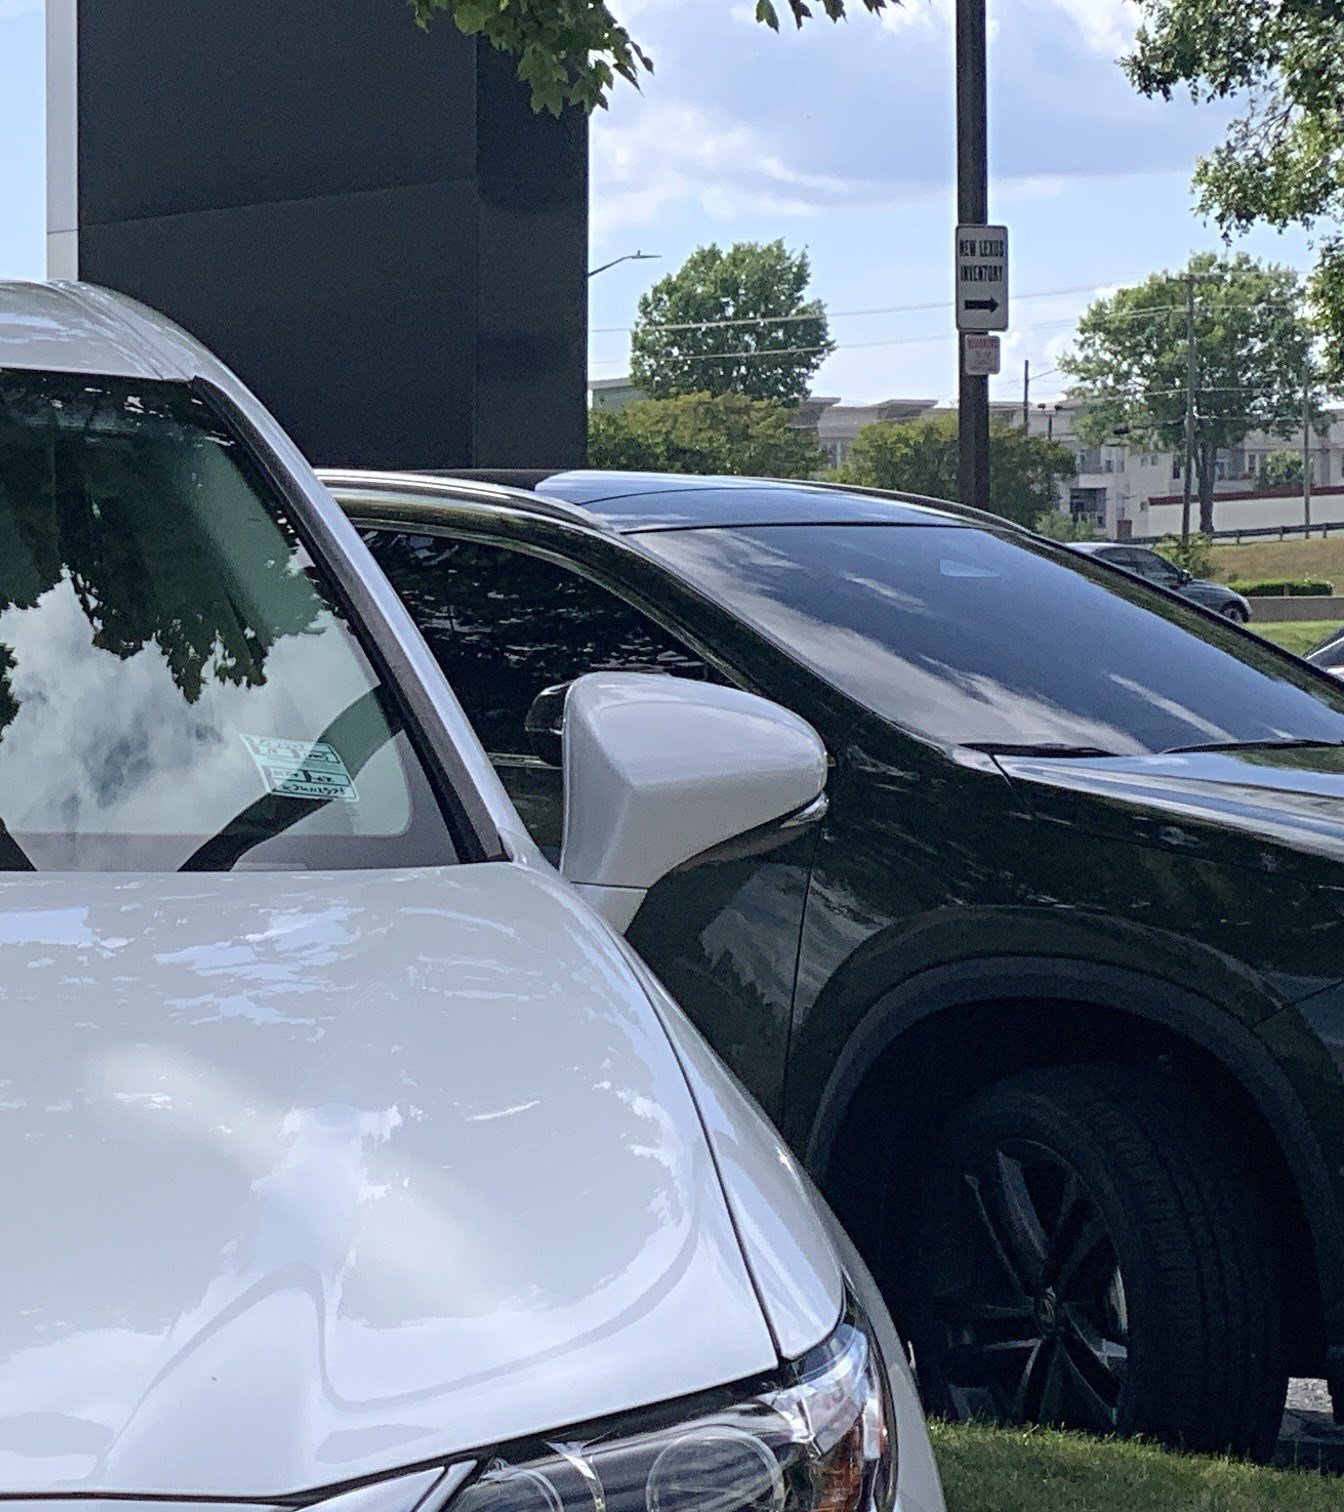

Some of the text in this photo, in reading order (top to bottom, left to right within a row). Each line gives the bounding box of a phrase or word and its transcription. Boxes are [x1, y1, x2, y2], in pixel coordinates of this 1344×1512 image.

[960, 240, 1004, 257] NEW LEXUS
[960, 265, 1003, 282] INVENTORY
